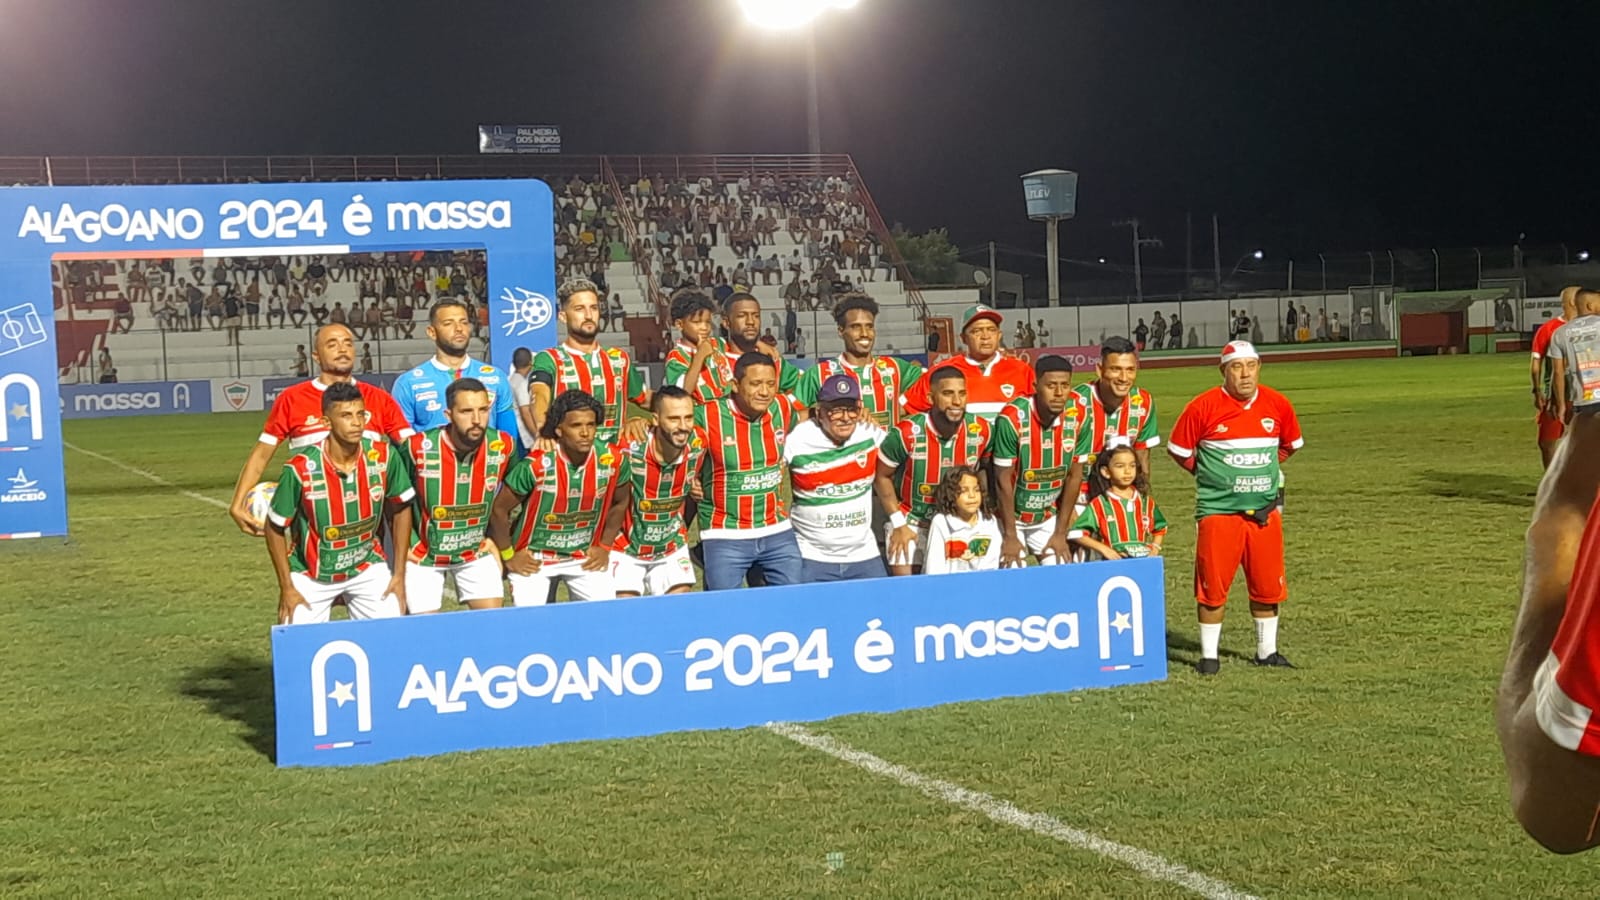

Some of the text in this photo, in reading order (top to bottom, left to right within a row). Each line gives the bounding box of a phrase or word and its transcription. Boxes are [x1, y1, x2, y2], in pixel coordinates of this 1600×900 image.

[517, 127, 559, 136] PALMEIRA
[17, 194, 512, 244] ALAGOANO 2024 é massa
[75, 391, 160, 412] massa
[1233, 485, 1252, 494] DOS
[1, 490, 47, 503] MACEIÓ
[825, 521, 844, 529] DOS
[439, 541, 459, 552] DOS
[545, 539, 566, 549] DOS
[397, 652, 663, 714] ALAGOANO
[684, 628, 834, 692] 2024
[853, 618, 896, 673] é
[914, 611, 1080, 663] massa
